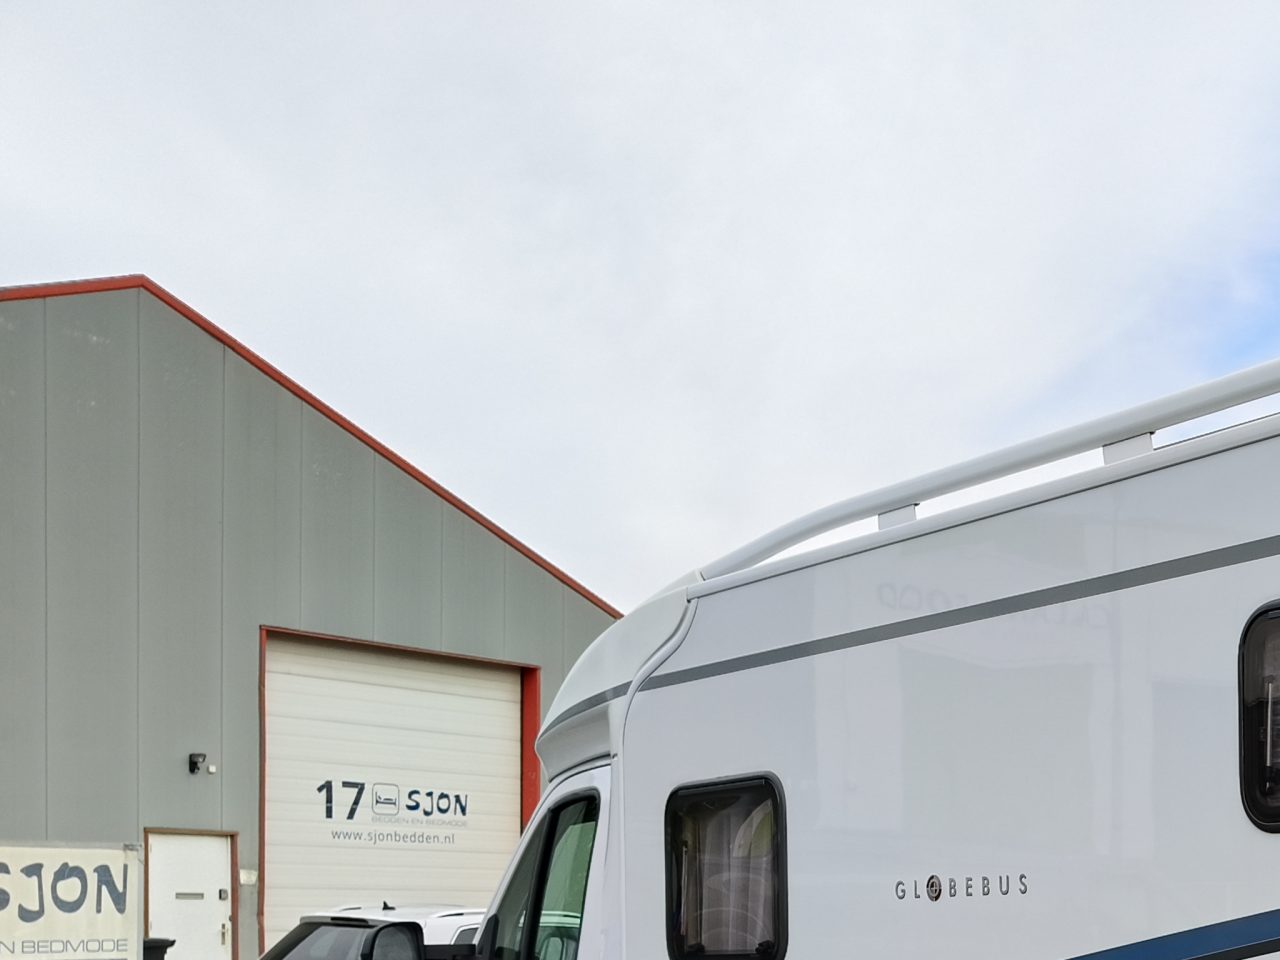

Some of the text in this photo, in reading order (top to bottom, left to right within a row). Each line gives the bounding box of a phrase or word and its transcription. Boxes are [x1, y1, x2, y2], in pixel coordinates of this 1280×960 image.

[316, 780, 366, 820] 17
[405, 789, 468, 817] SJON
[331, 830, 455, 845] www.sjonbedden.nl
[895, 873, 1028, 902] GLOBEBUS
[22, 939, 128, 954] BEDMODE
